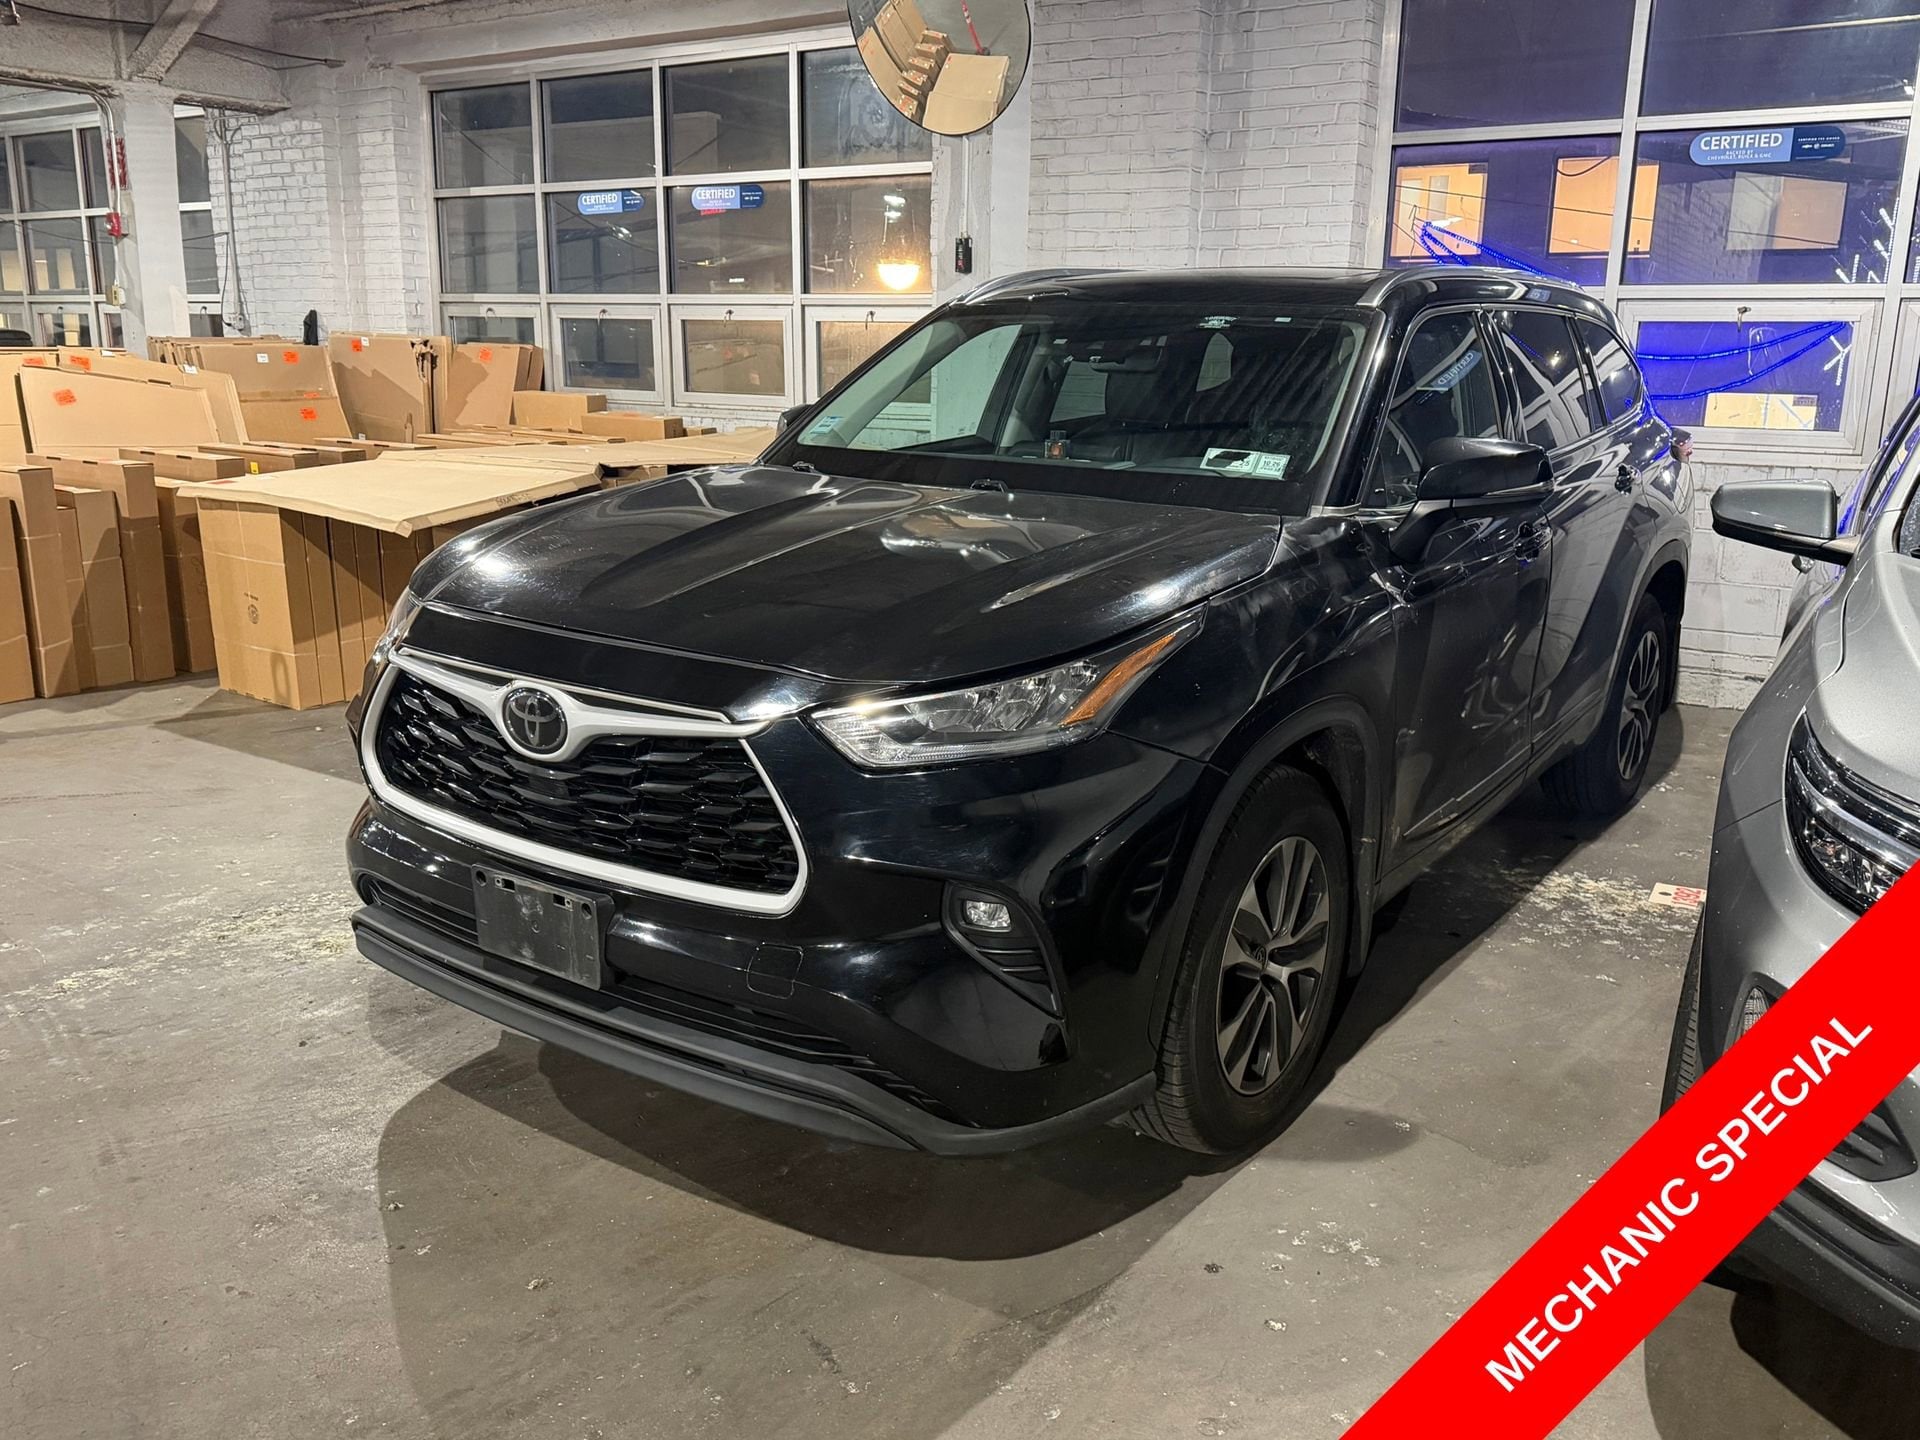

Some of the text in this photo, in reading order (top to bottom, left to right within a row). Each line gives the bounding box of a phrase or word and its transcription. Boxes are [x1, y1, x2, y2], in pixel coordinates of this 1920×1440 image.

[1700, 133, 1783, 150] CERTIFIED
[581, 193, 618, 205] CERTIFIED
[696, 188, 736, 200] CERTIFIED
